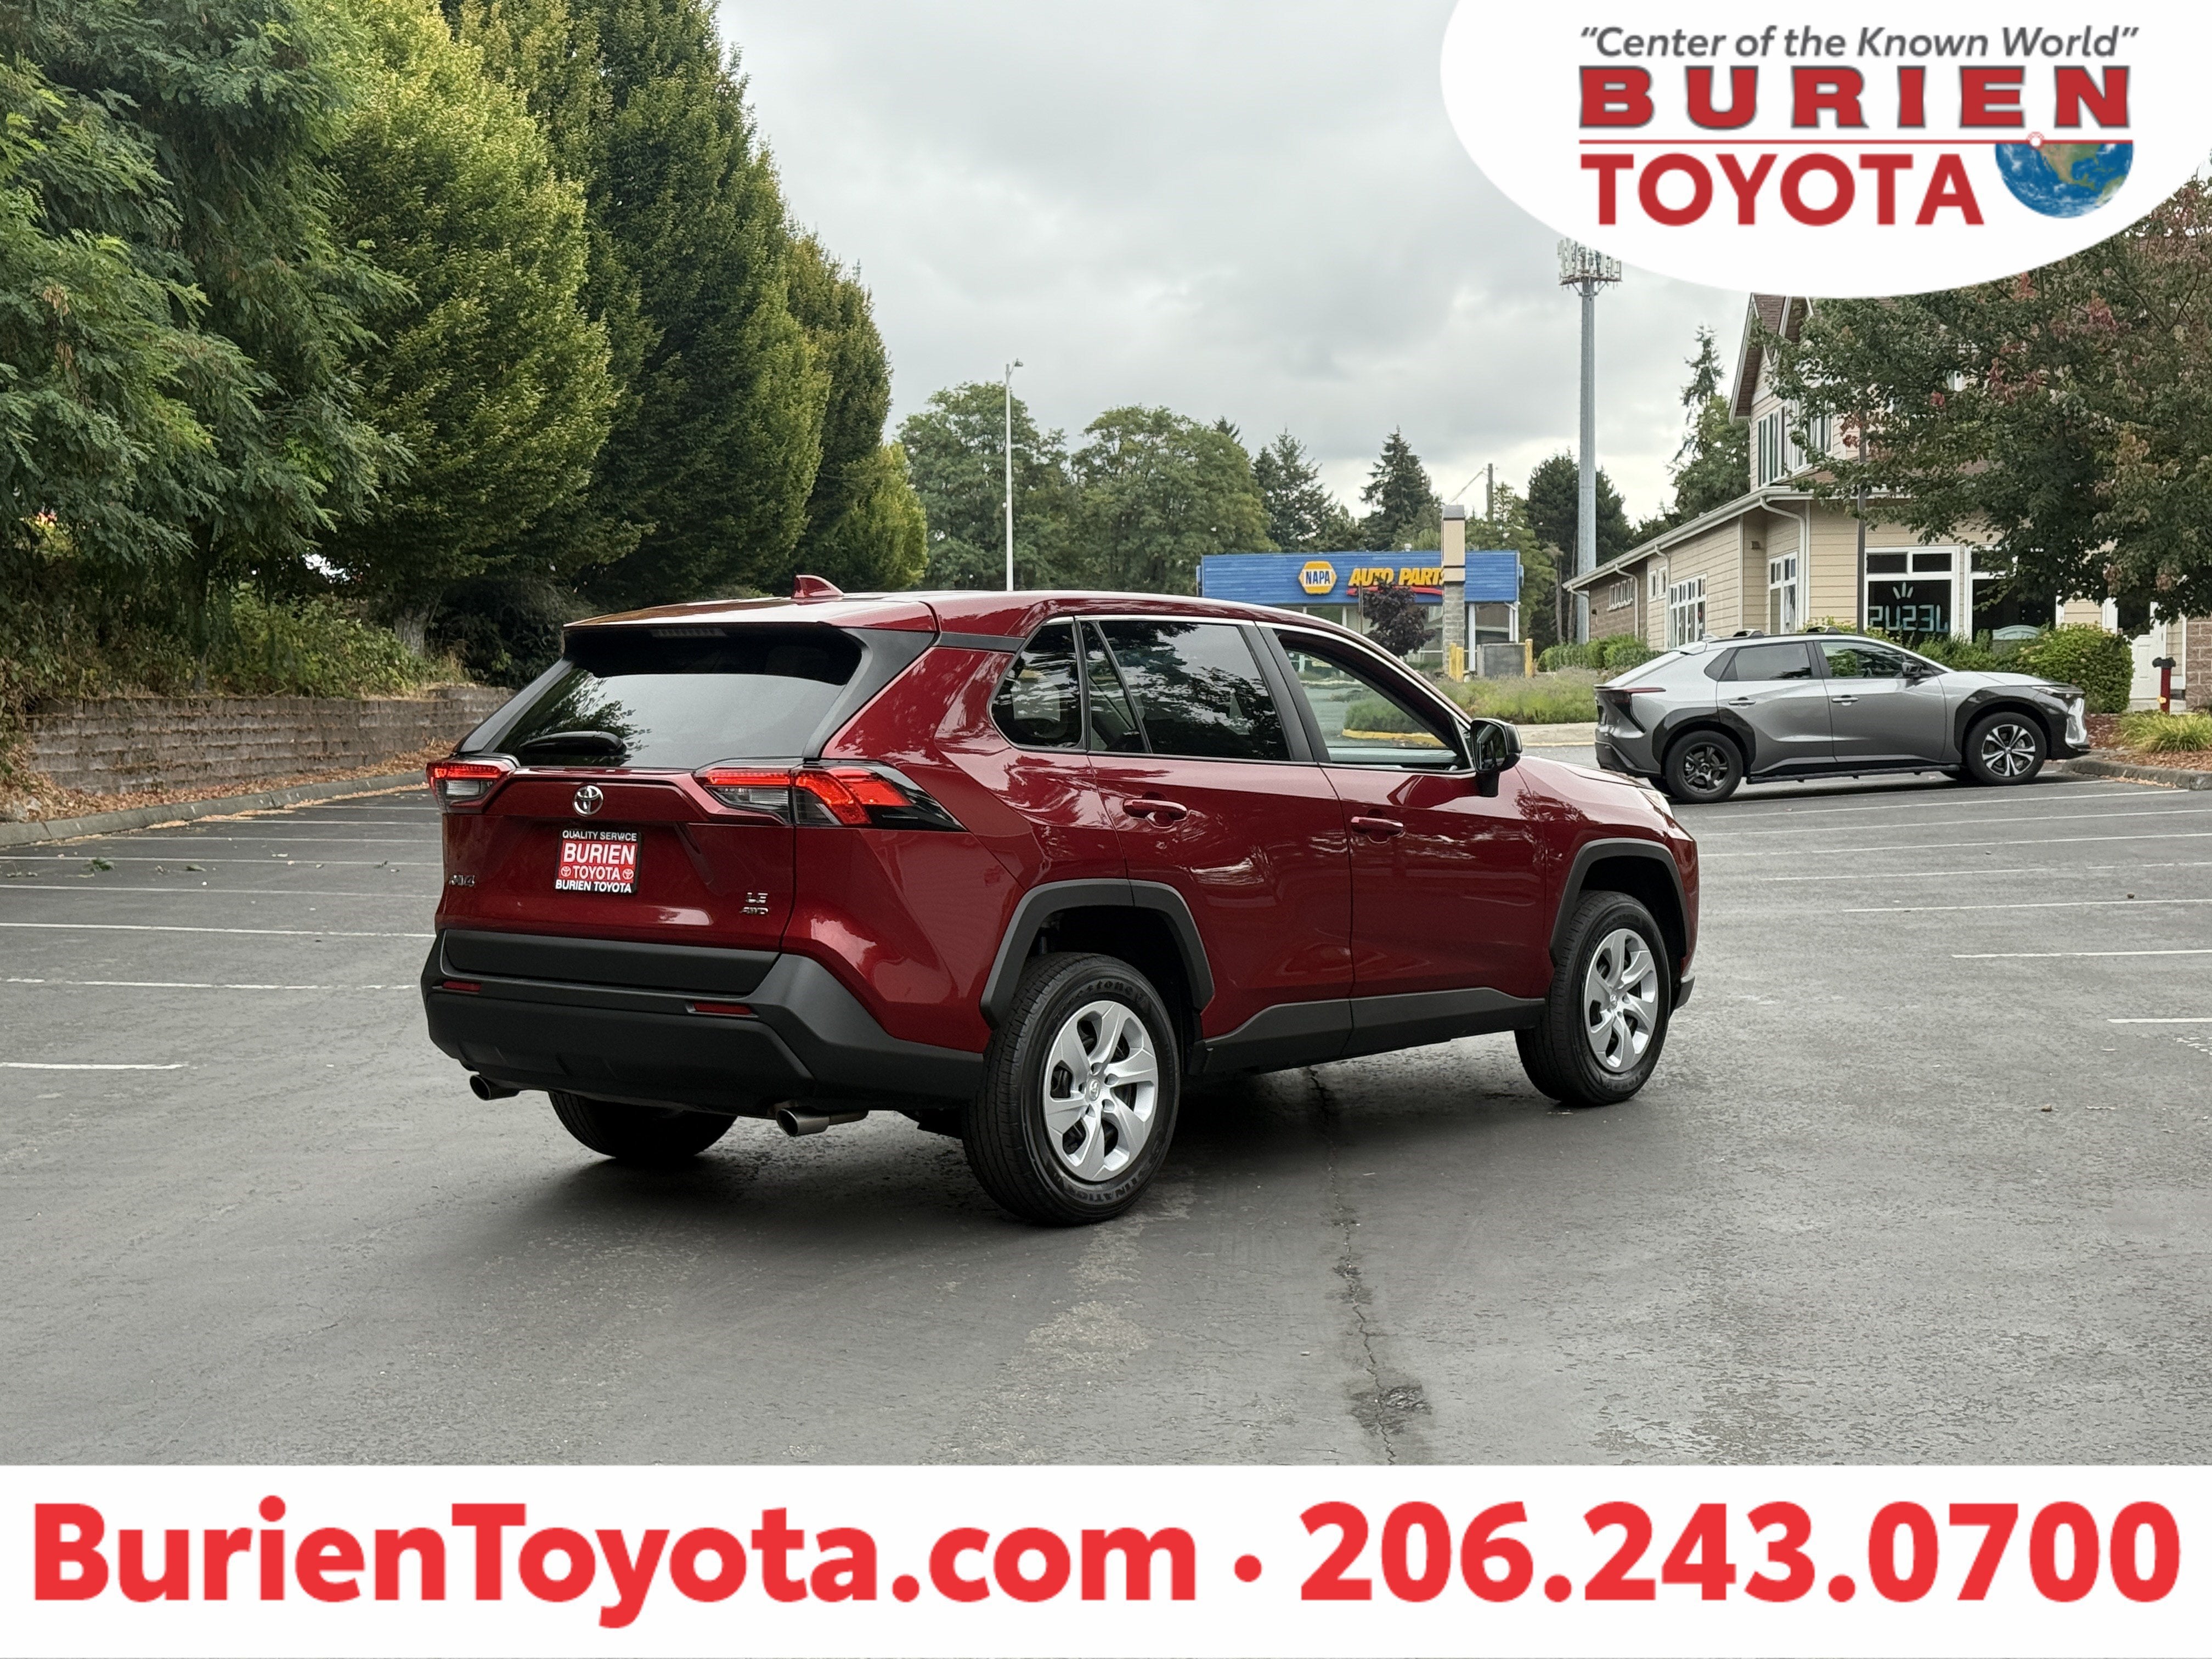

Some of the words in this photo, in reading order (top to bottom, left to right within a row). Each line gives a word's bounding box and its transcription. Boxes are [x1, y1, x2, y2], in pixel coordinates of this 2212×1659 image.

[1306, 571, 1330, 584] NAPA
[1348, 567, 1395, 586] AUTO
[562, 830, 598, 840] QUALITY
[600, 831, 637, 842] SERVICE
[563, 842, 635, 865] BURIEN
[573, 865, 621, 881] TOYOTA
[555, 879, 591, 891] BURIEN
[594, 881, 631, 893] TOYOTA
